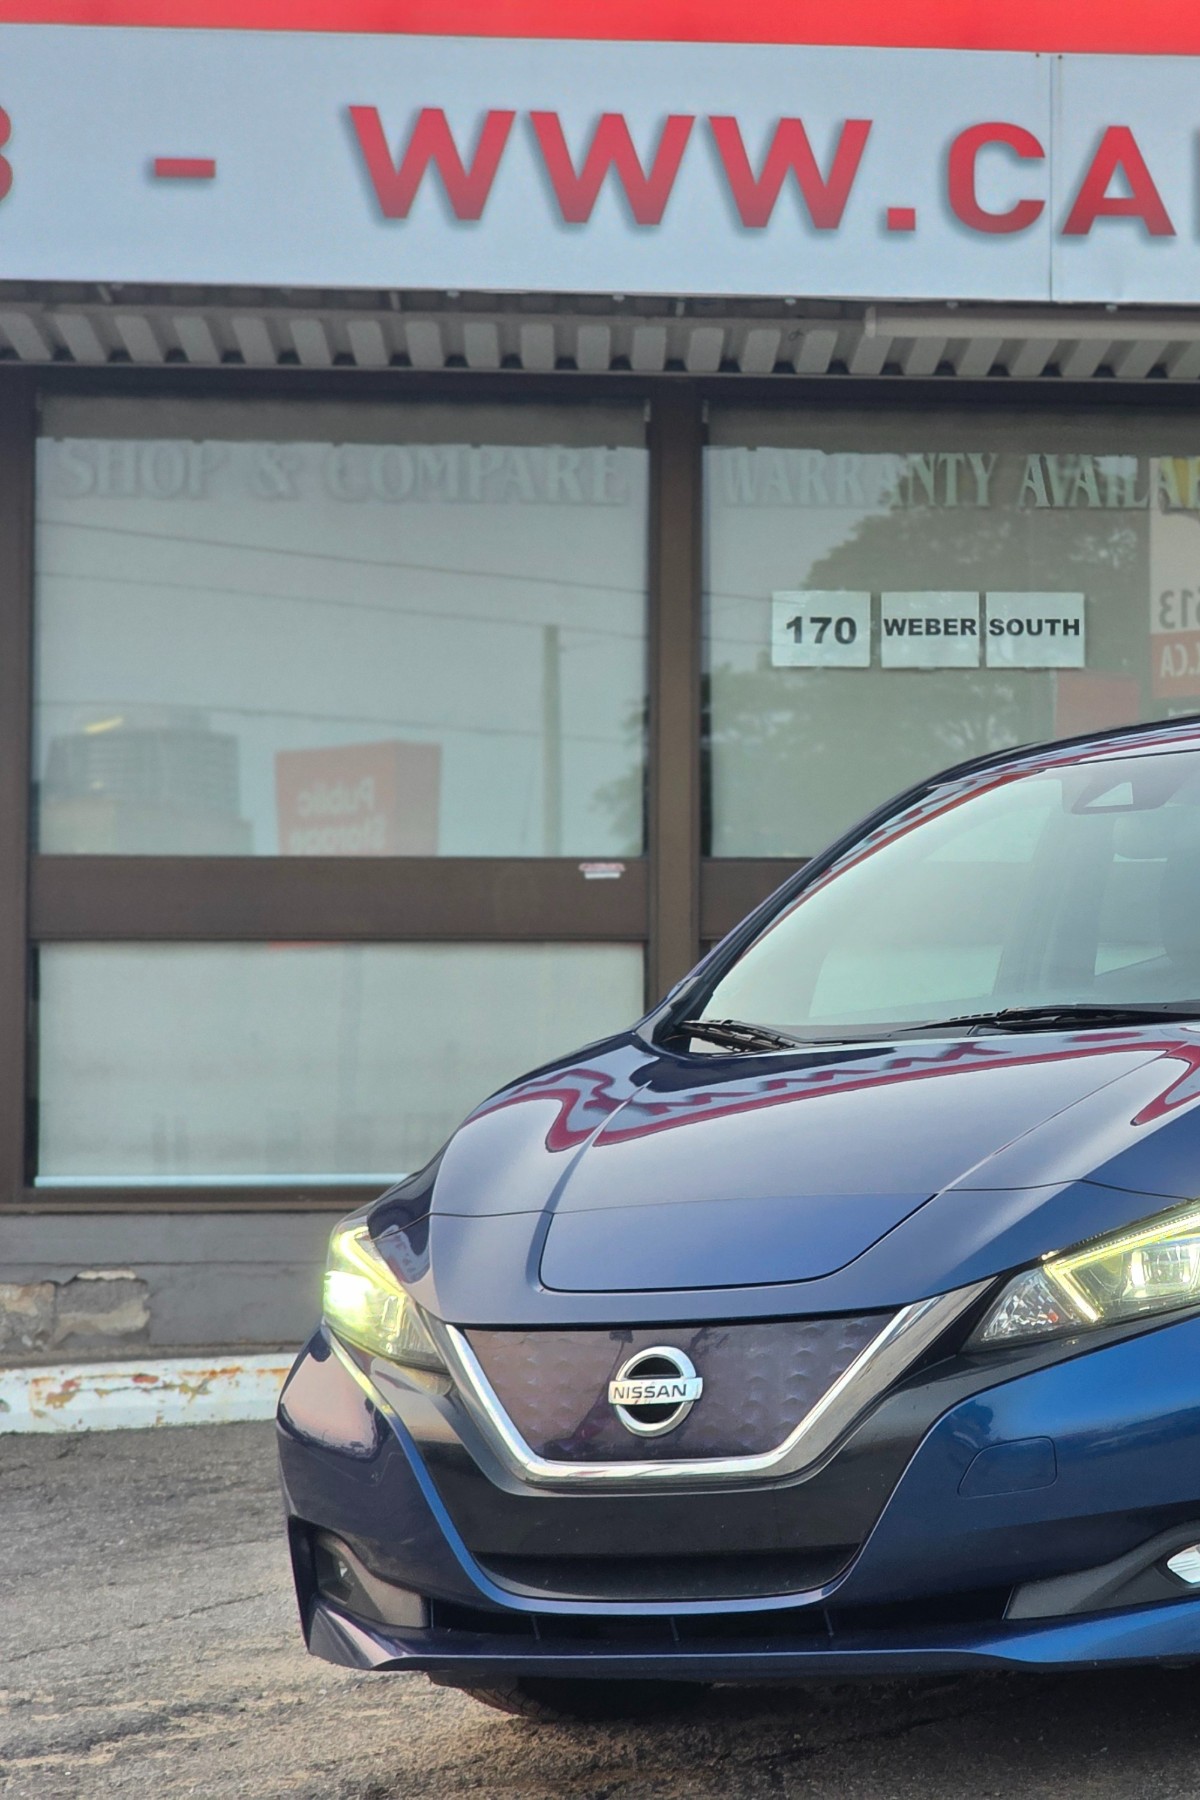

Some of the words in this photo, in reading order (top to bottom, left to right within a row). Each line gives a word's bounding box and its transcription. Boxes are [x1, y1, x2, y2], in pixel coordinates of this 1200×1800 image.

[60, 440, 216, 500] SHOP
[325, 443, 628, 506] COMPARE
[722, 449, 997, 509] WARRANTY
[786, 615, 857, 645] 170
[883, 617, 978, 637] WEBER
[988, 617, 1081, 637] SOUTH
[612, 1383, 688, 1400] NISSAN
